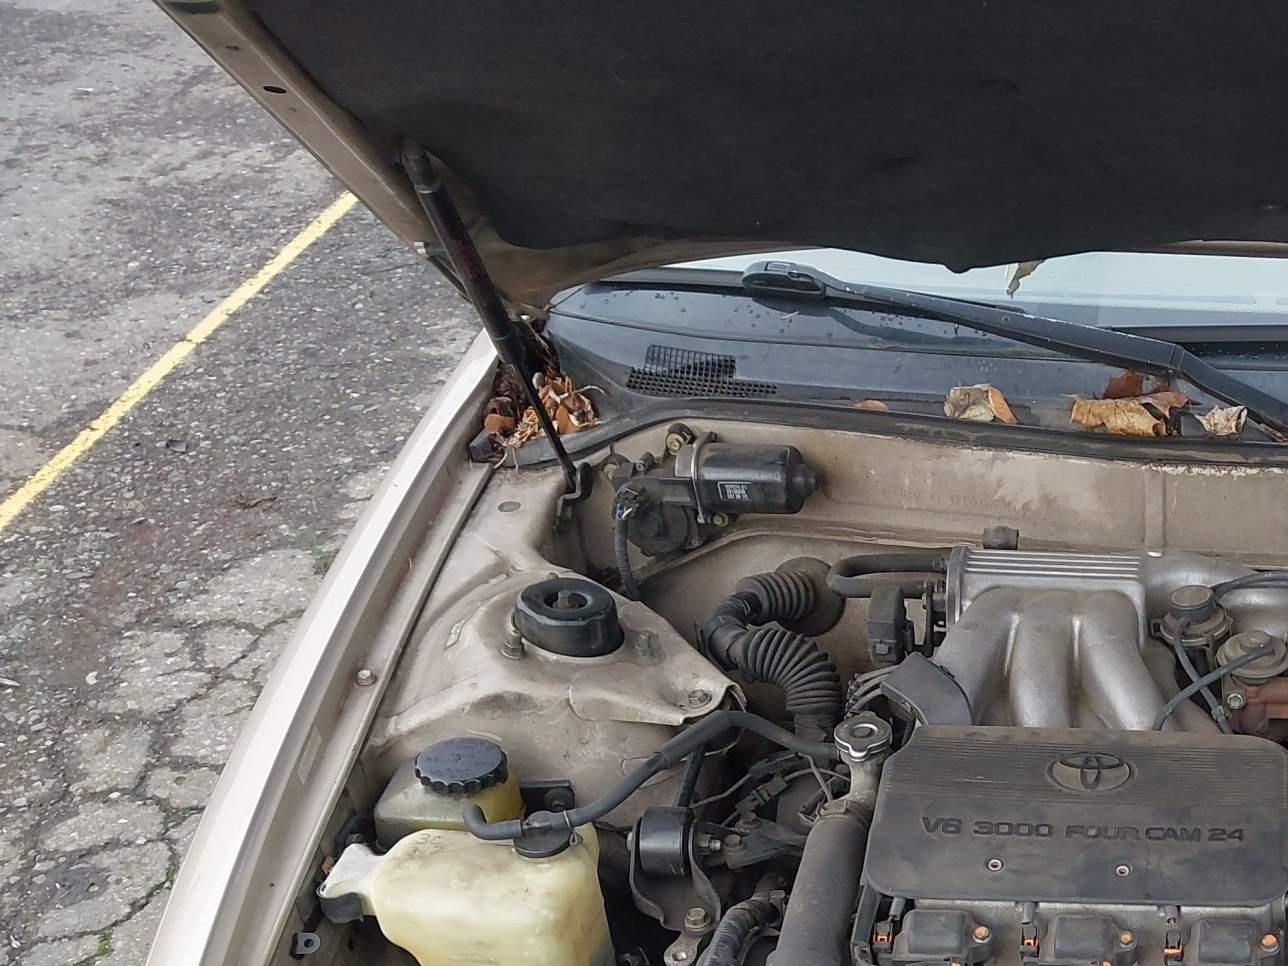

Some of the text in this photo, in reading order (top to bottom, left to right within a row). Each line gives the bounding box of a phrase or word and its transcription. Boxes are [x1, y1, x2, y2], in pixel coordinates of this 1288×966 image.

[921, 816, 1245, 841] V6 3000 FOUR CAM 24
